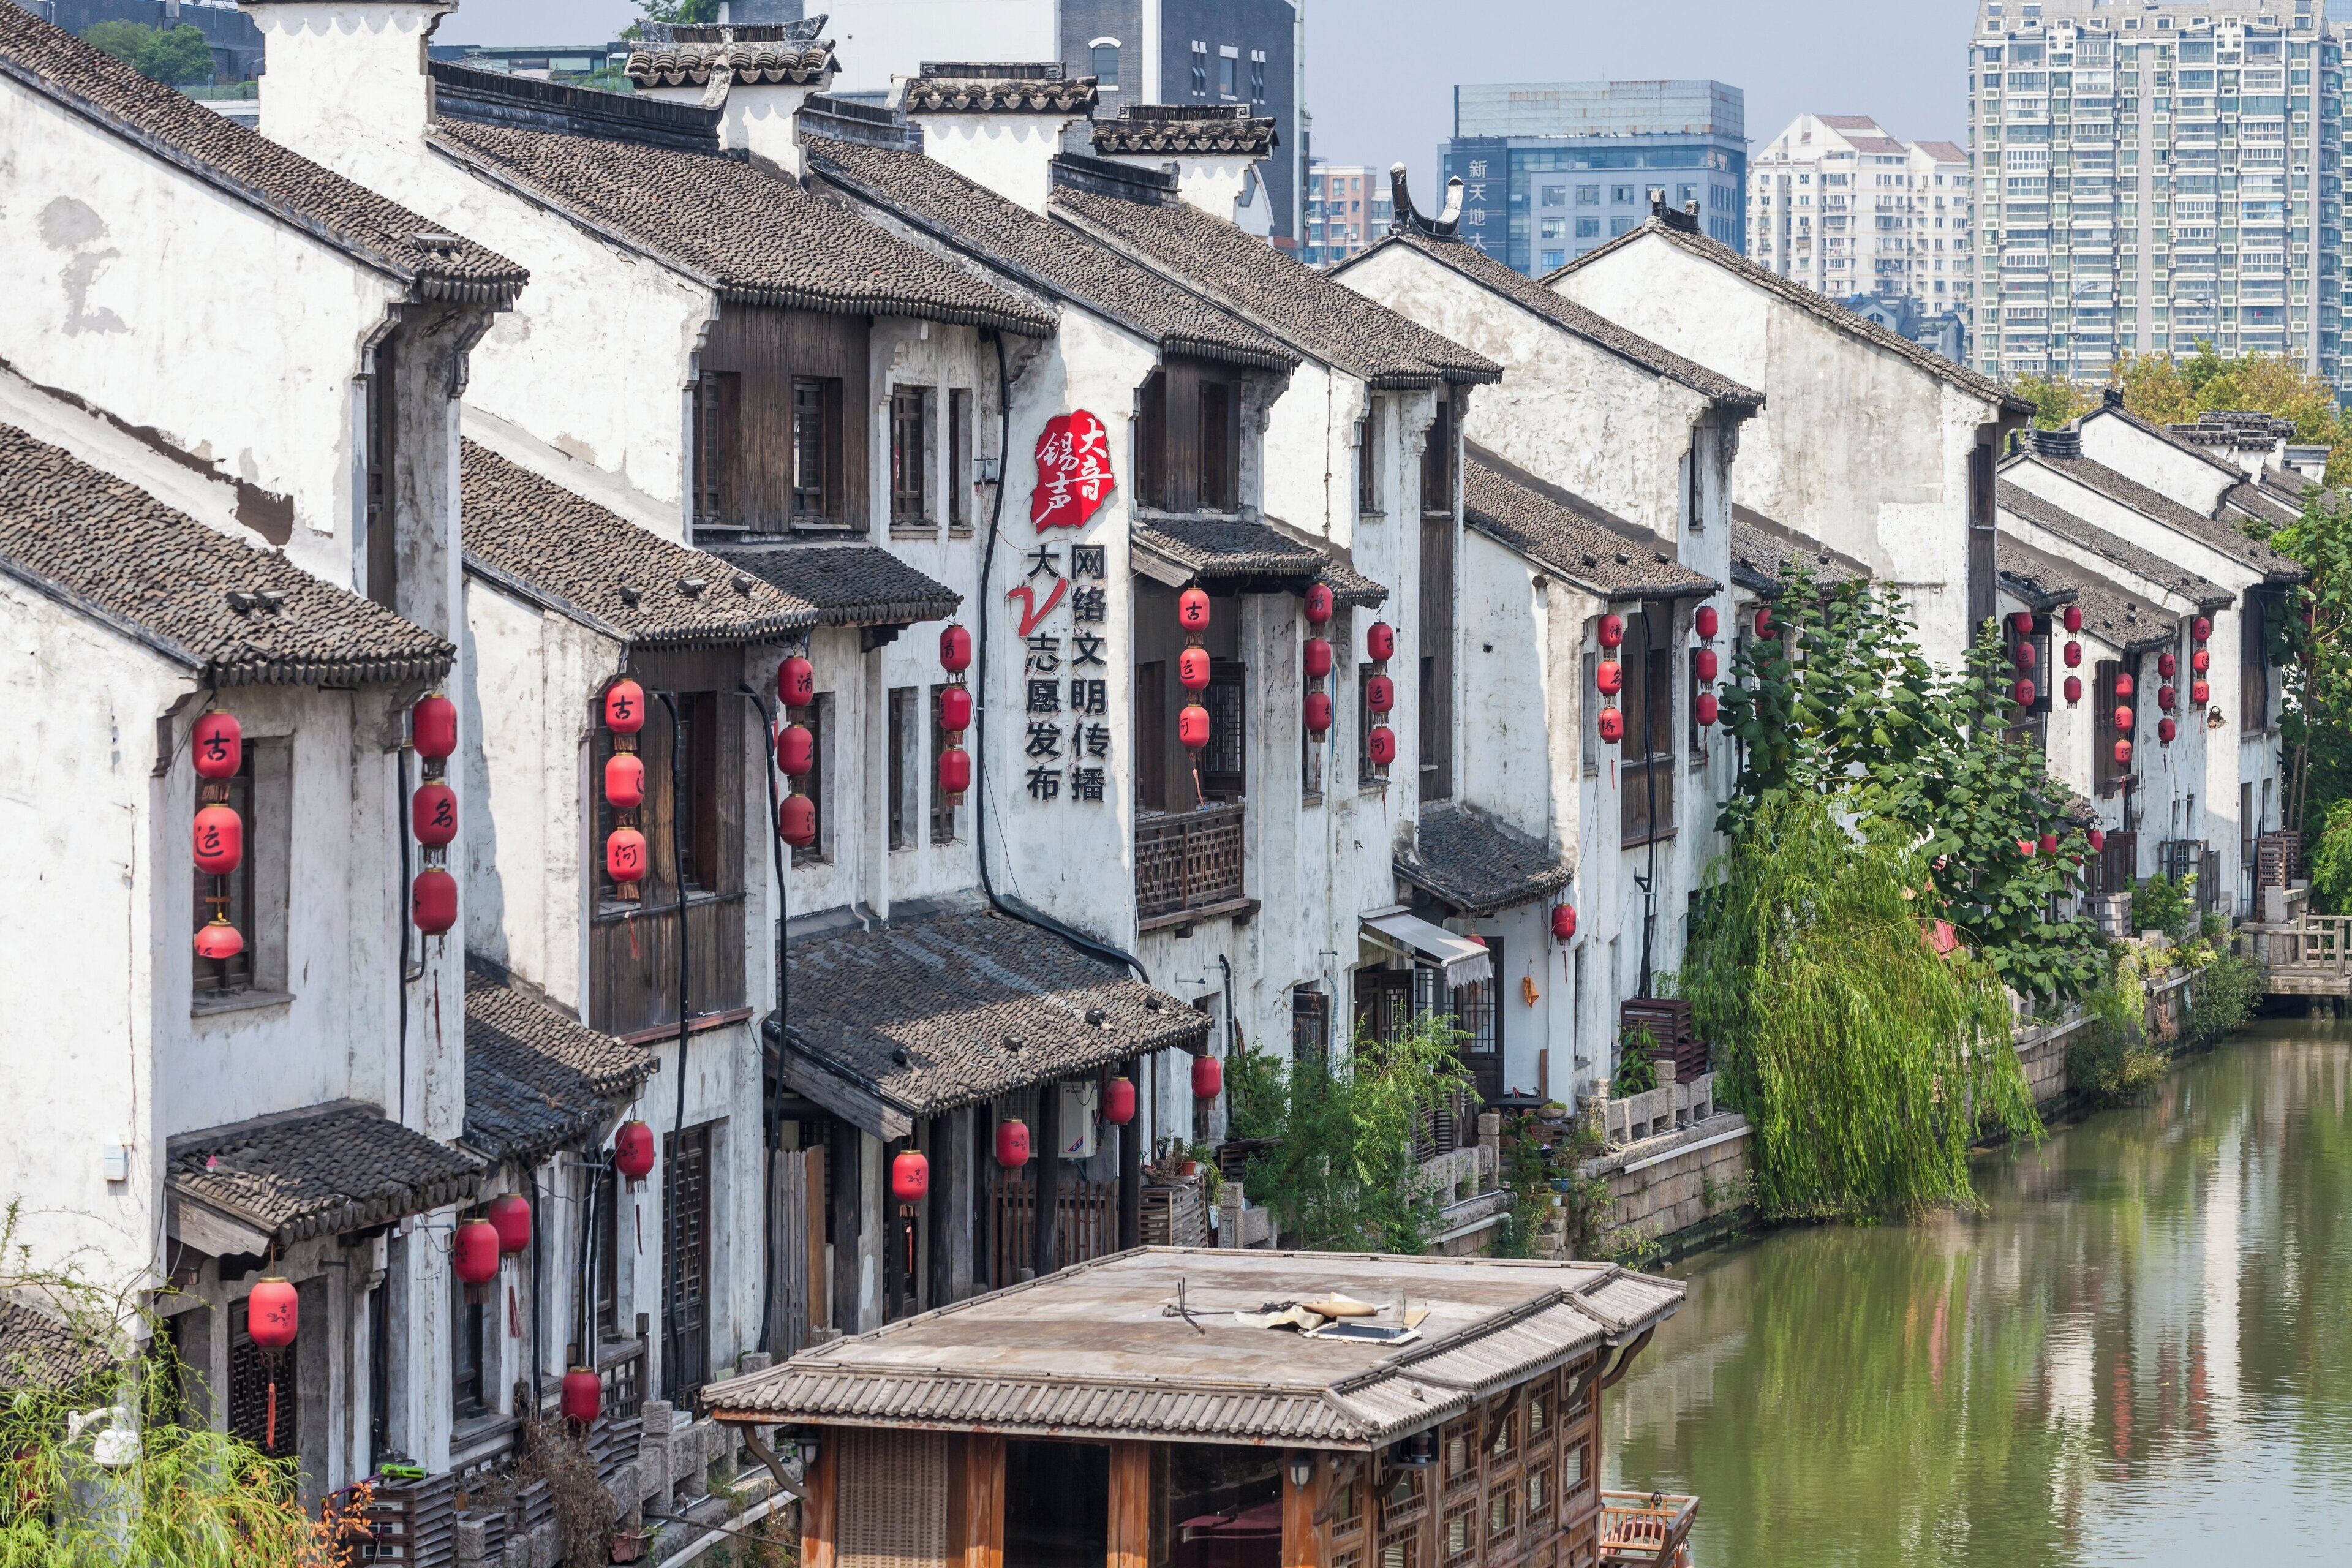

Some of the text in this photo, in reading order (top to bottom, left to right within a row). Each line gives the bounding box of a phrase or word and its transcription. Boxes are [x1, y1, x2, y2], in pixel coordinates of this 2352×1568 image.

[1185, 601, 1202, 620] 古
[1309, 592, 1324, 611] 清
[797, 670, 813, 693] 清
[1071, 544, 1109, 801] 网络文明传播
[612, 695, 633, 720] 古
[203, 729, 230, 761] 古
[430, 798, 453, 827] 名
[615, 843, 636, 869] 河
